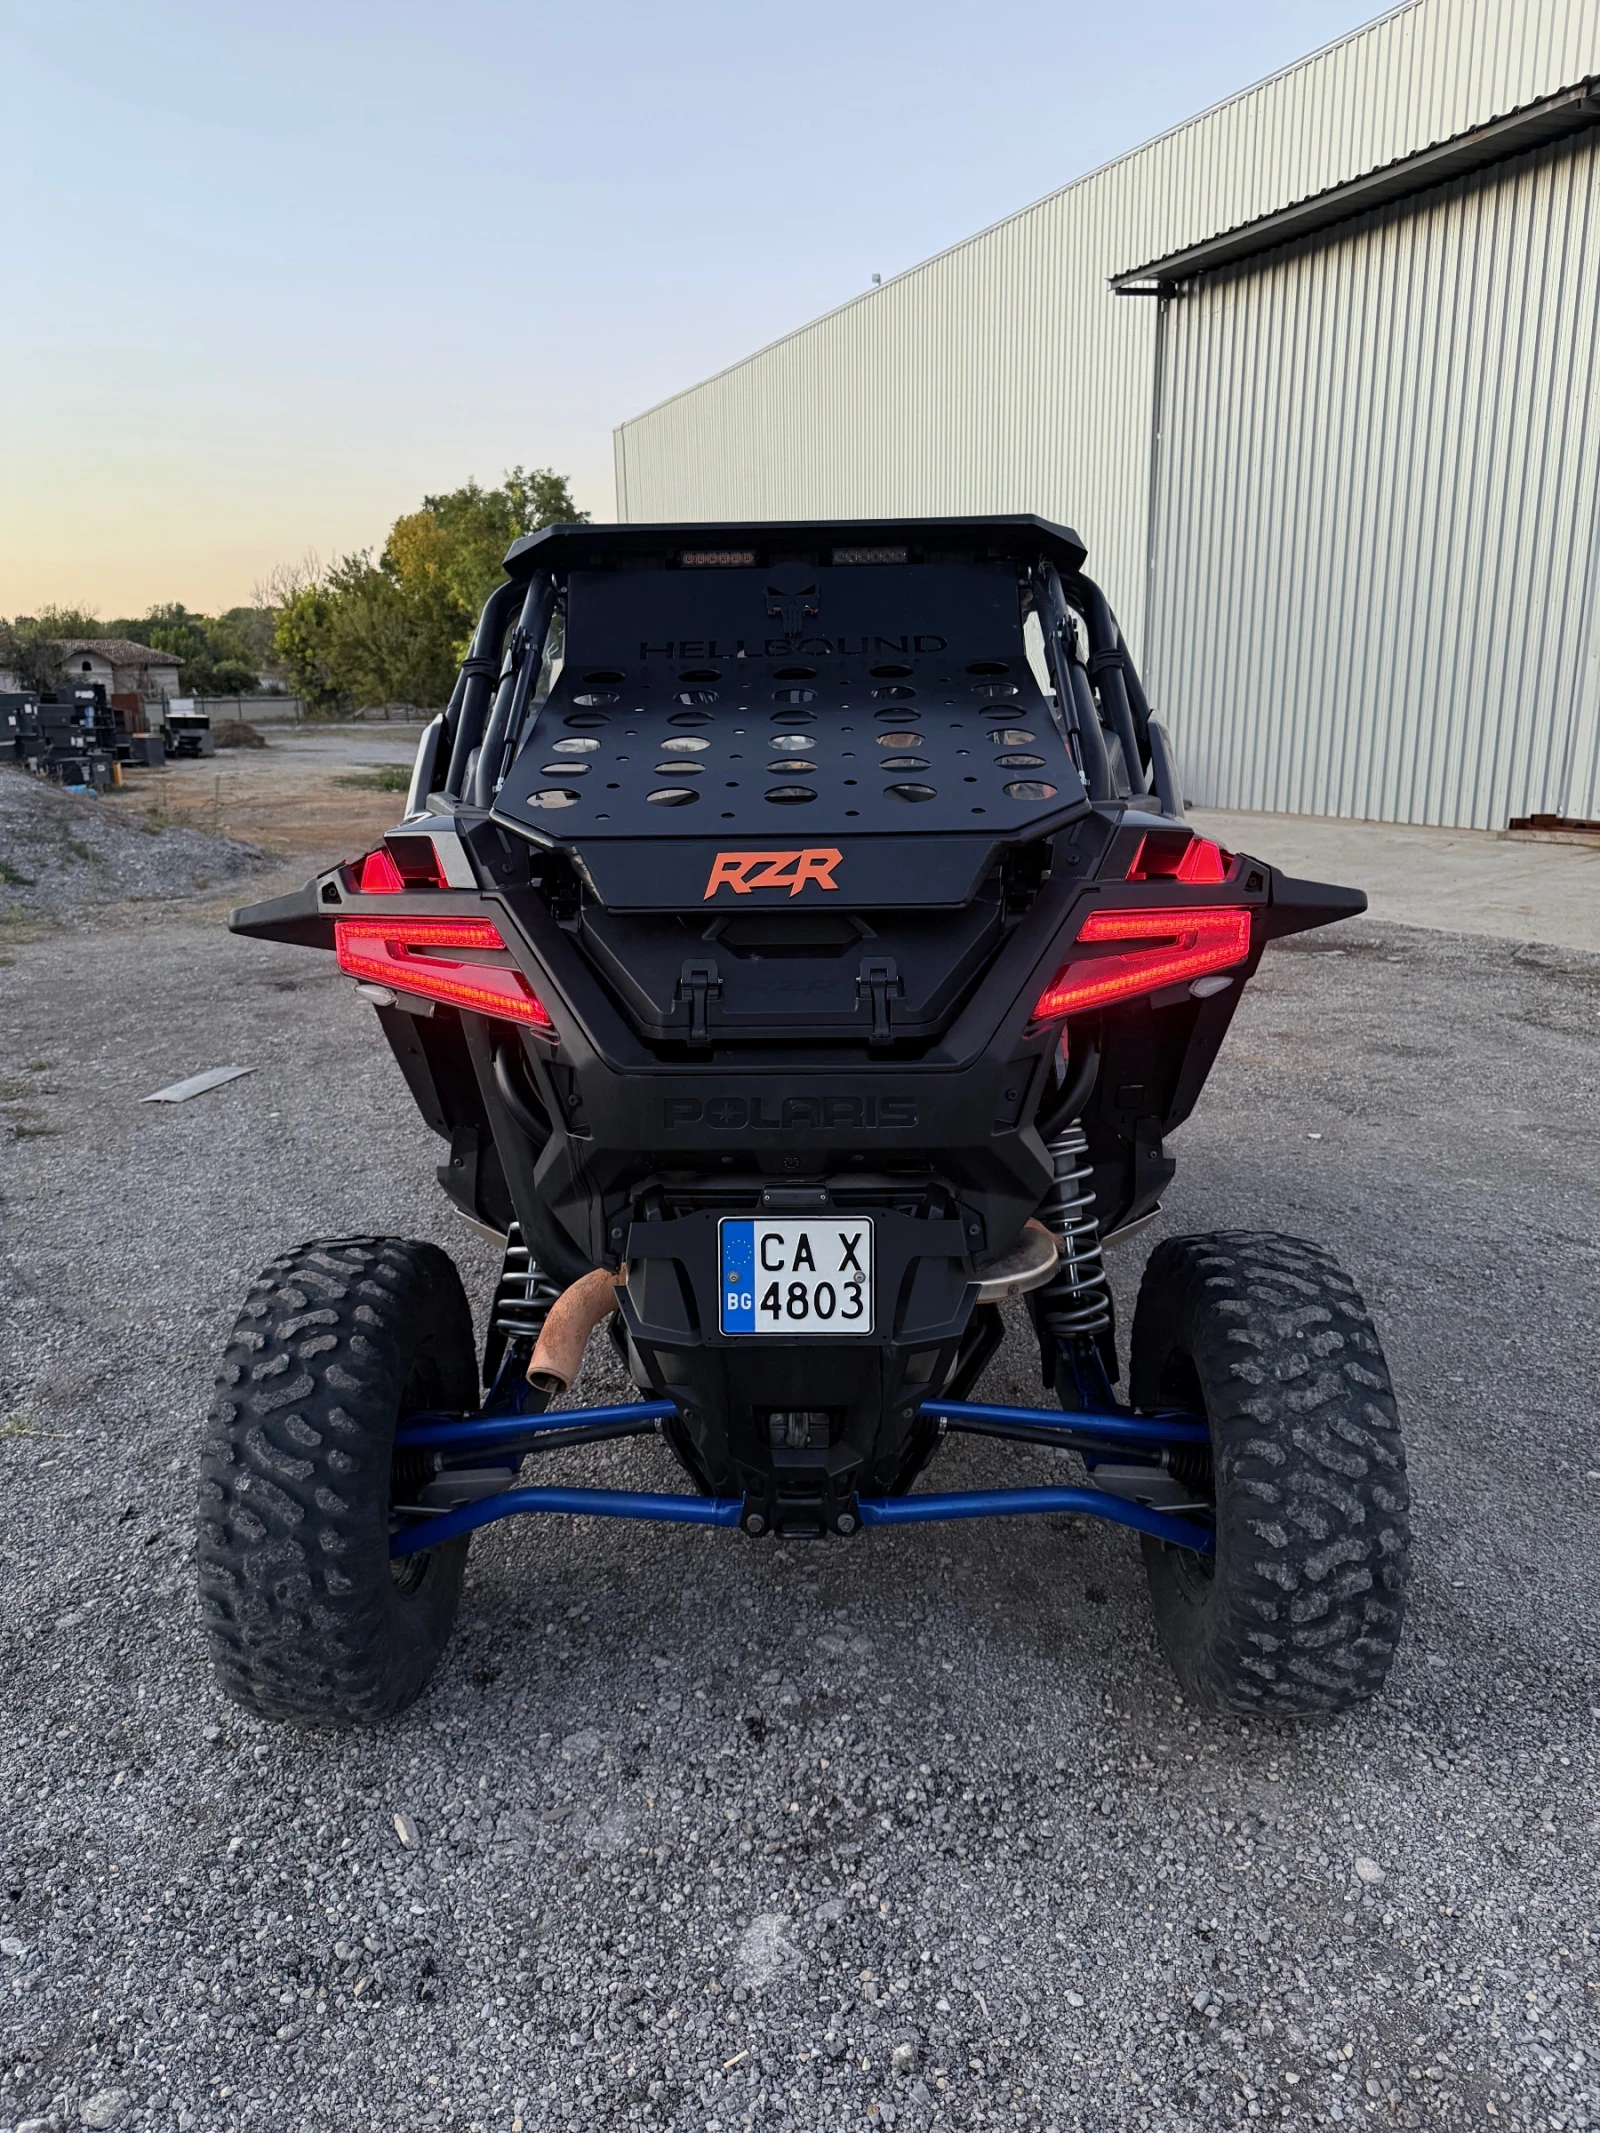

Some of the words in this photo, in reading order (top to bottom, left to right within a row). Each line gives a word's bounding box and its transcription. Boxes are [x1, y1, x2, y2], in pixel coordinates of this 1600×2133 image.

[639, 634, 948, 660] HELLBOUND
[703, 848, 844, 901] RZR
[663, 1096, 920, 1130] POLARIS
[760, 1233, 817, 1271] CA
[837, 1233, 862, 1271] X
[727, 1292, 752, 1310] BG
[760, 1281, 864, 1320] 4803
